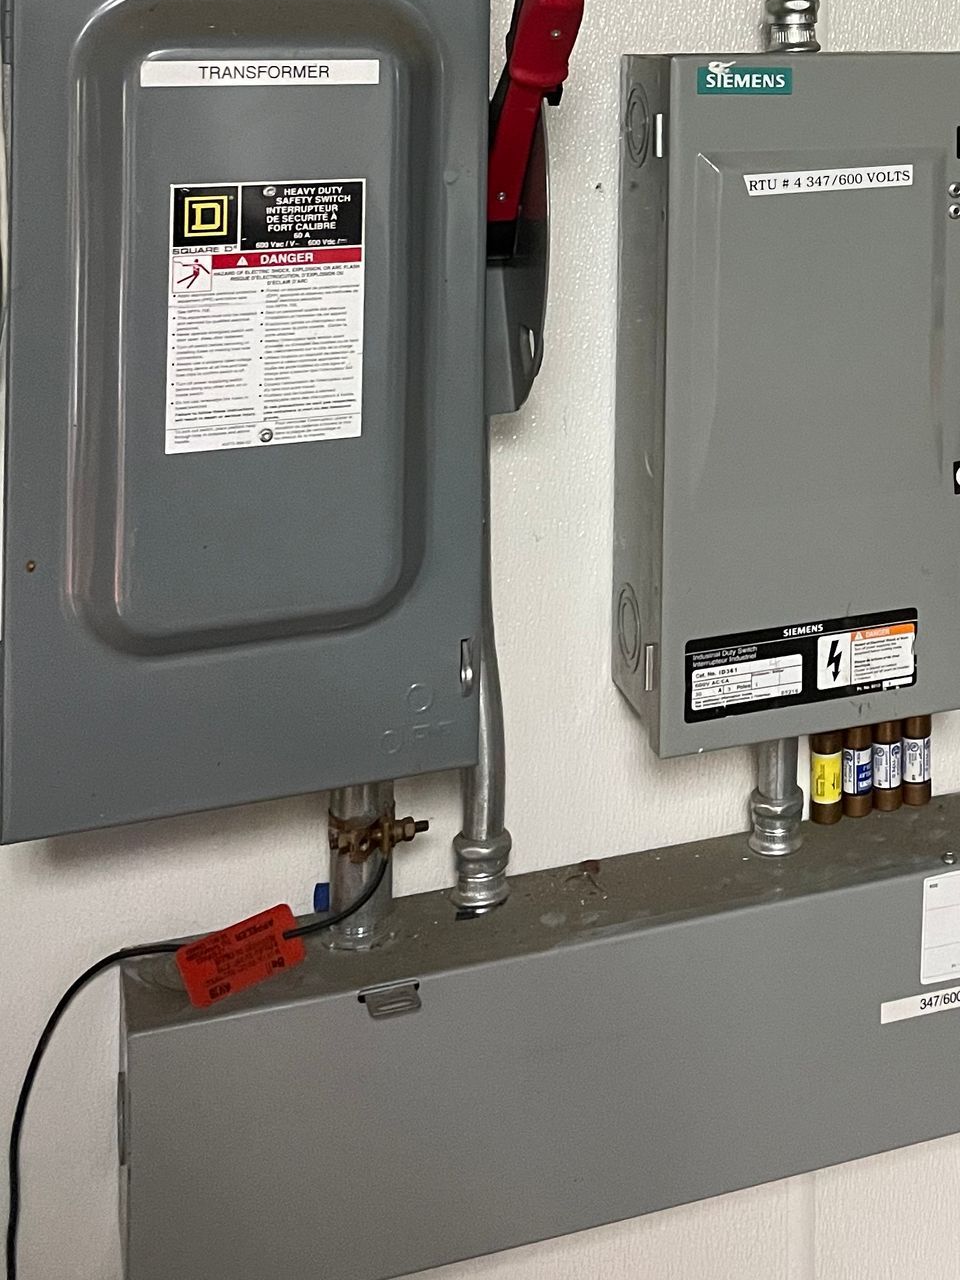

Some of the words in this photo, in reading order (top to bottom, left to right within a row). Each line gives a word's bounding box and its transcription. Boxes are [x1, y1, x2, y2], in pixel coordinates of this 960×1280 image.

[197, 65, 330, 80] TRANSFORMER
[706, 72, 786, 89] SIEMENS
[748, 178, 777, 192] RTU
[782, 179, 790, 190] #
[794, 177, 802, 188] 4
[806, 174, 864, 188] 347/600
[866, 170, 911, 184] VOLTS
[284, 187, 316, 196] HEAVY
[318, 186, 344, 194] DUTY
[276, 196, 312, 205] SAFETY
[314, 194, 351, 203] SWITCH
[266, 204, 338, 214] INTERRUPTEUR
[266, 215, 280, 224] DE
[268, 224, 292, 232] FORT
[295, 222, 336, 231] CALIBRE
[172, 246, 220, 255] SQUARE
[260, 252, 314, 264] DANGER
[783, 624, 824, 638] SIEMENS
